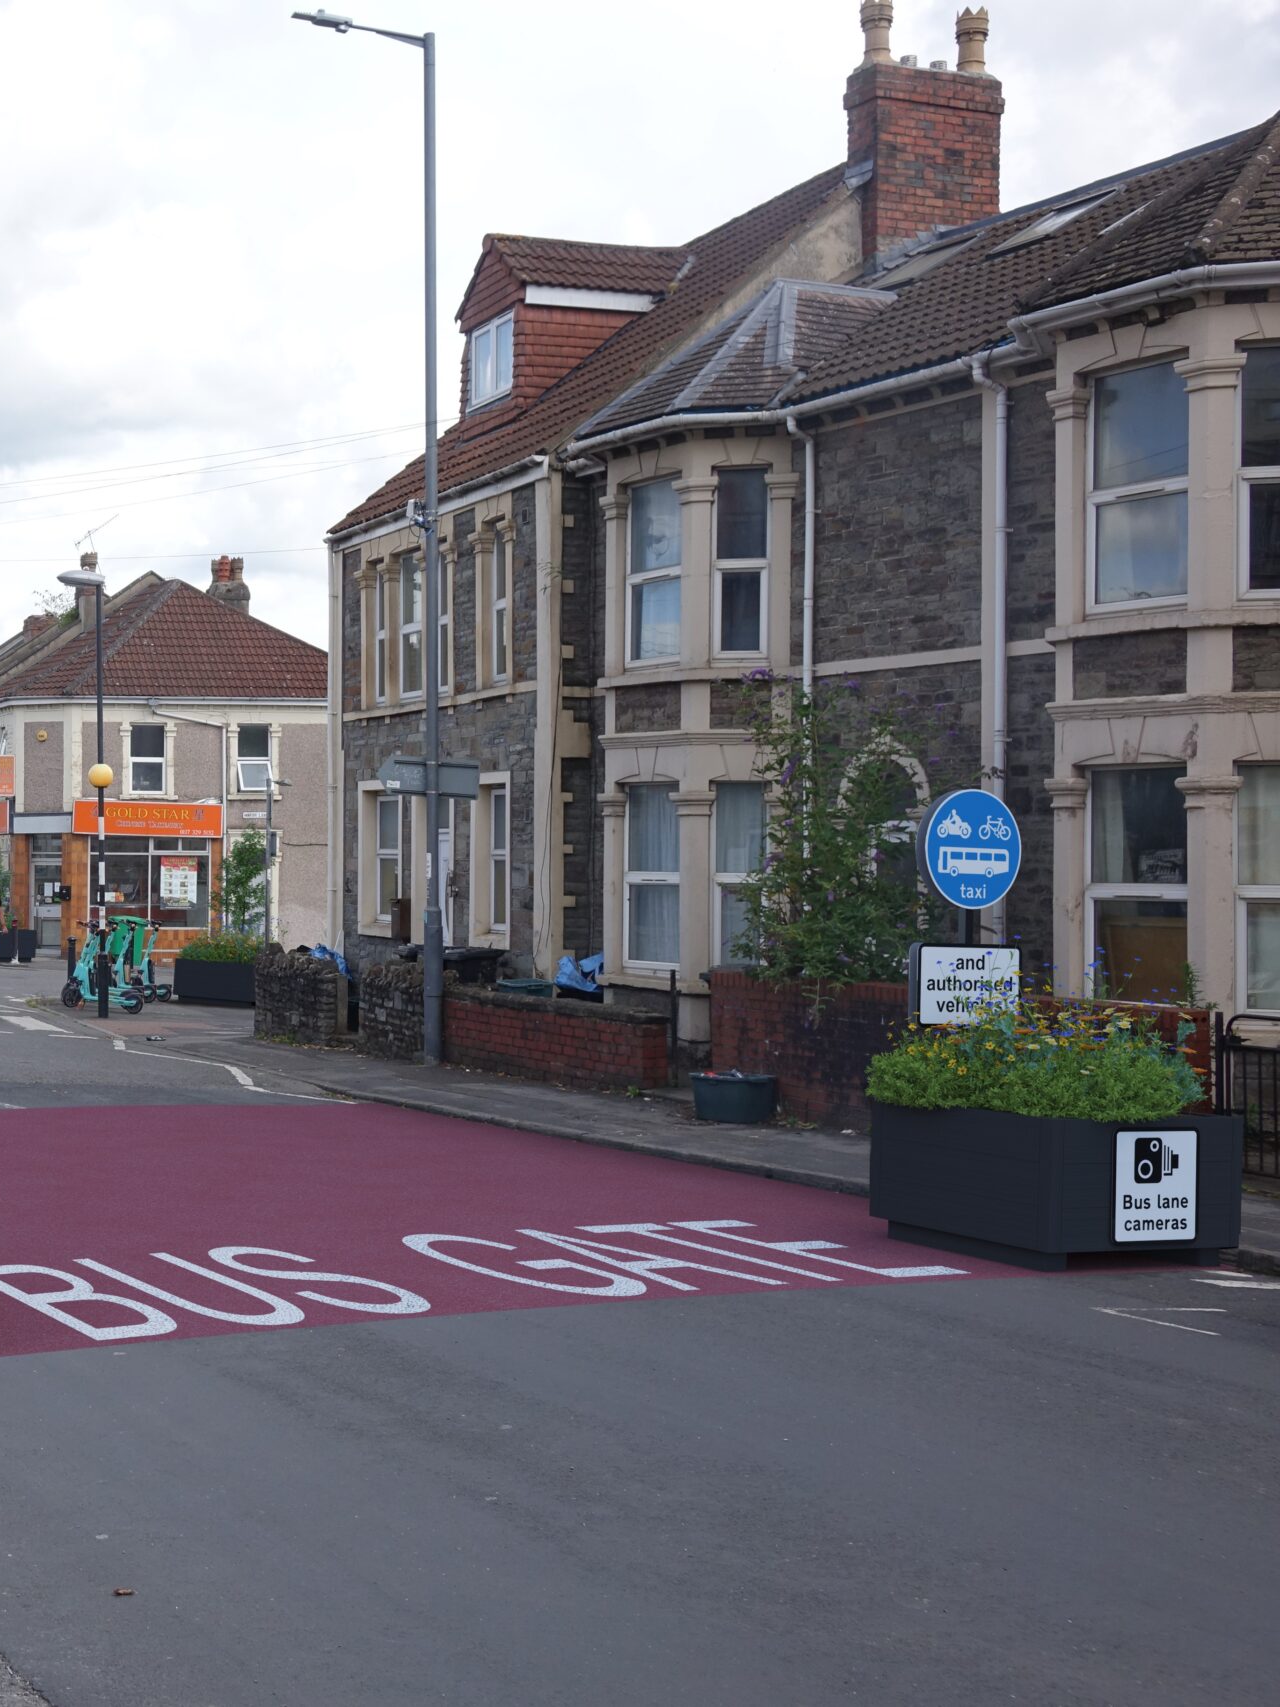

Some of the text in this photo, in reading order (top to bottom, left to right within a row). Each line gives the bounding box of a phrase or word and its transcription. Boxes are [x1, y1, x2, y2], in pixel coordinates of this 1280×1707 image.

[106, 807, 190, 820] GOLD STAR
[960, 883, 987, 899] taxi
[955, 954, 986, 971] and
[1123, 1194, 1189, 1210] Bus lane
[1124, 1218, 1188, 1232] cameras
[401, 1219, 972, 1297] GATE
